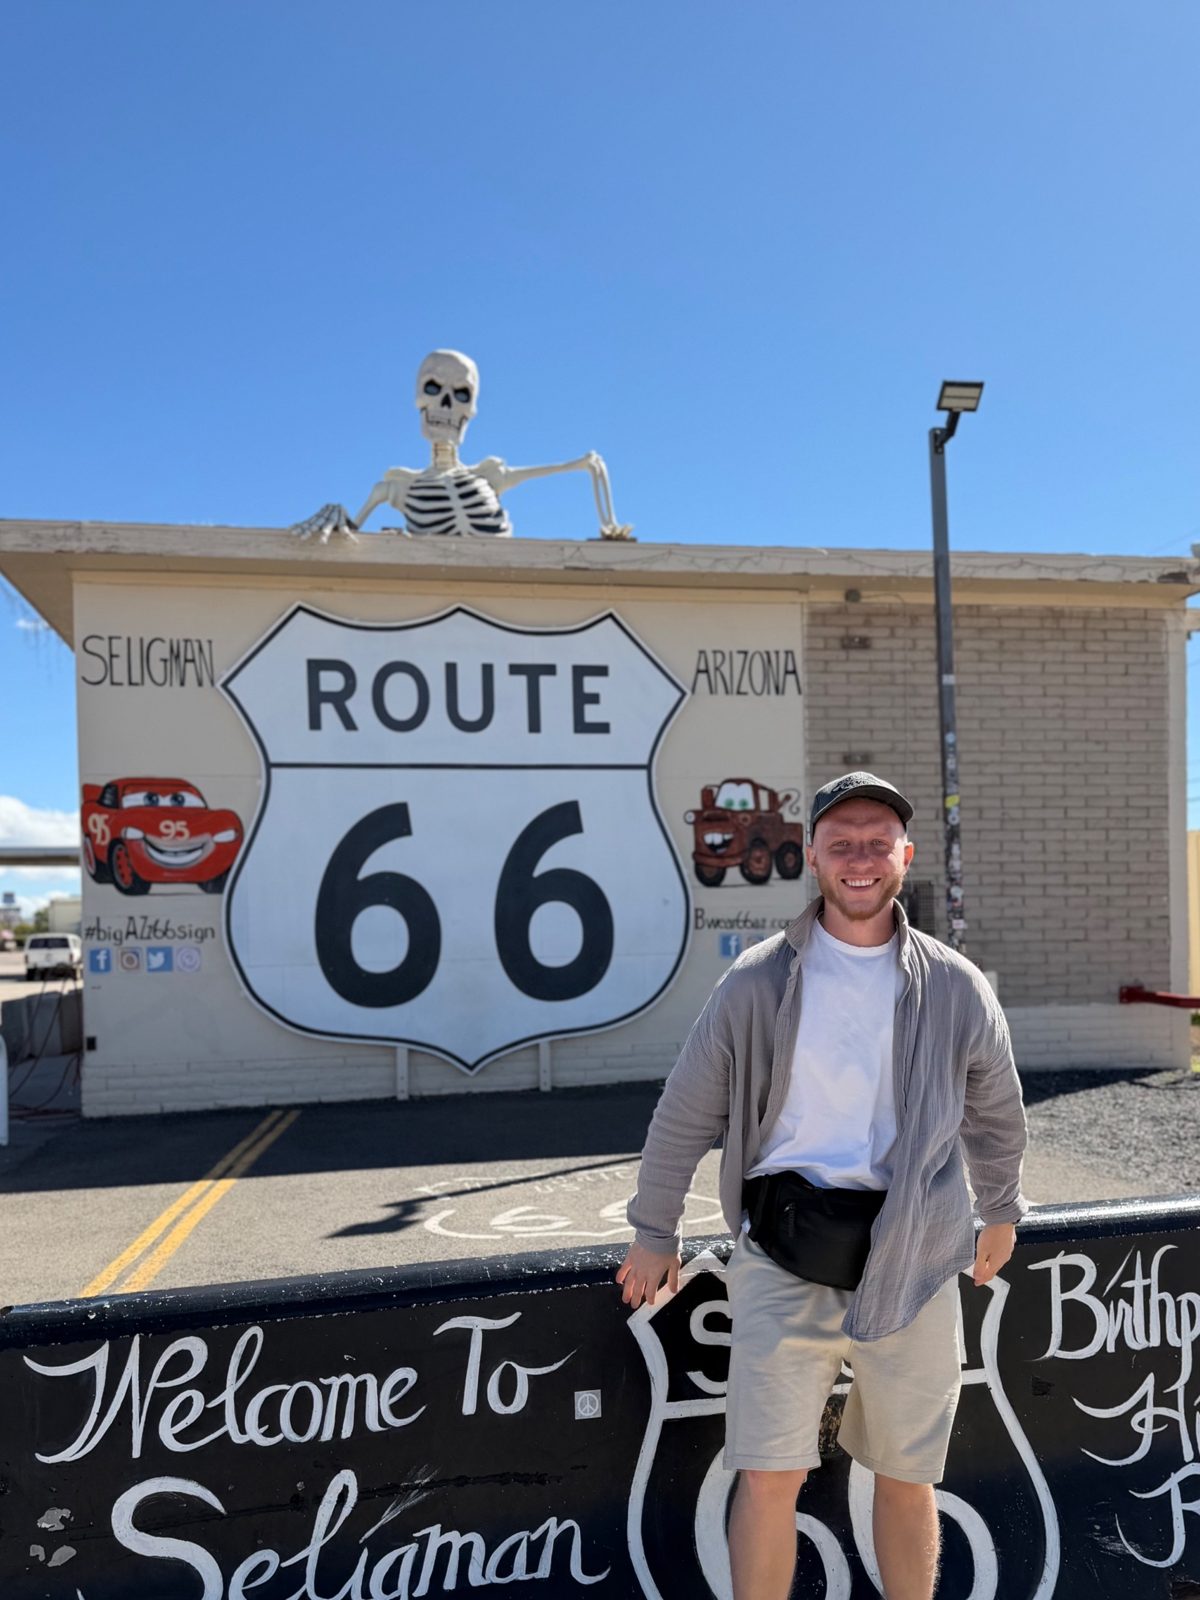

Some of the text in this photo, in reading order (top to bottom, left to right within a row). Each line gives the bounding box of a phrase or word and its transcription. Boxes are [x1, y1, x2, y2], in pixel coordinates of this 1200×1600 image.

[82, 635, 215, 688] SELIGMAN
[691, 649, 802, 696] ARIZONA
[306, 658, 611, 734] ROUTE
[88, 813, 111, 846] 95
[159, 819, 190, 840] 95
[315, 799, 614, 1008] 66
[23, 1326, 427, 1464] Welcome
[433, 1311, 577, 1415] To
